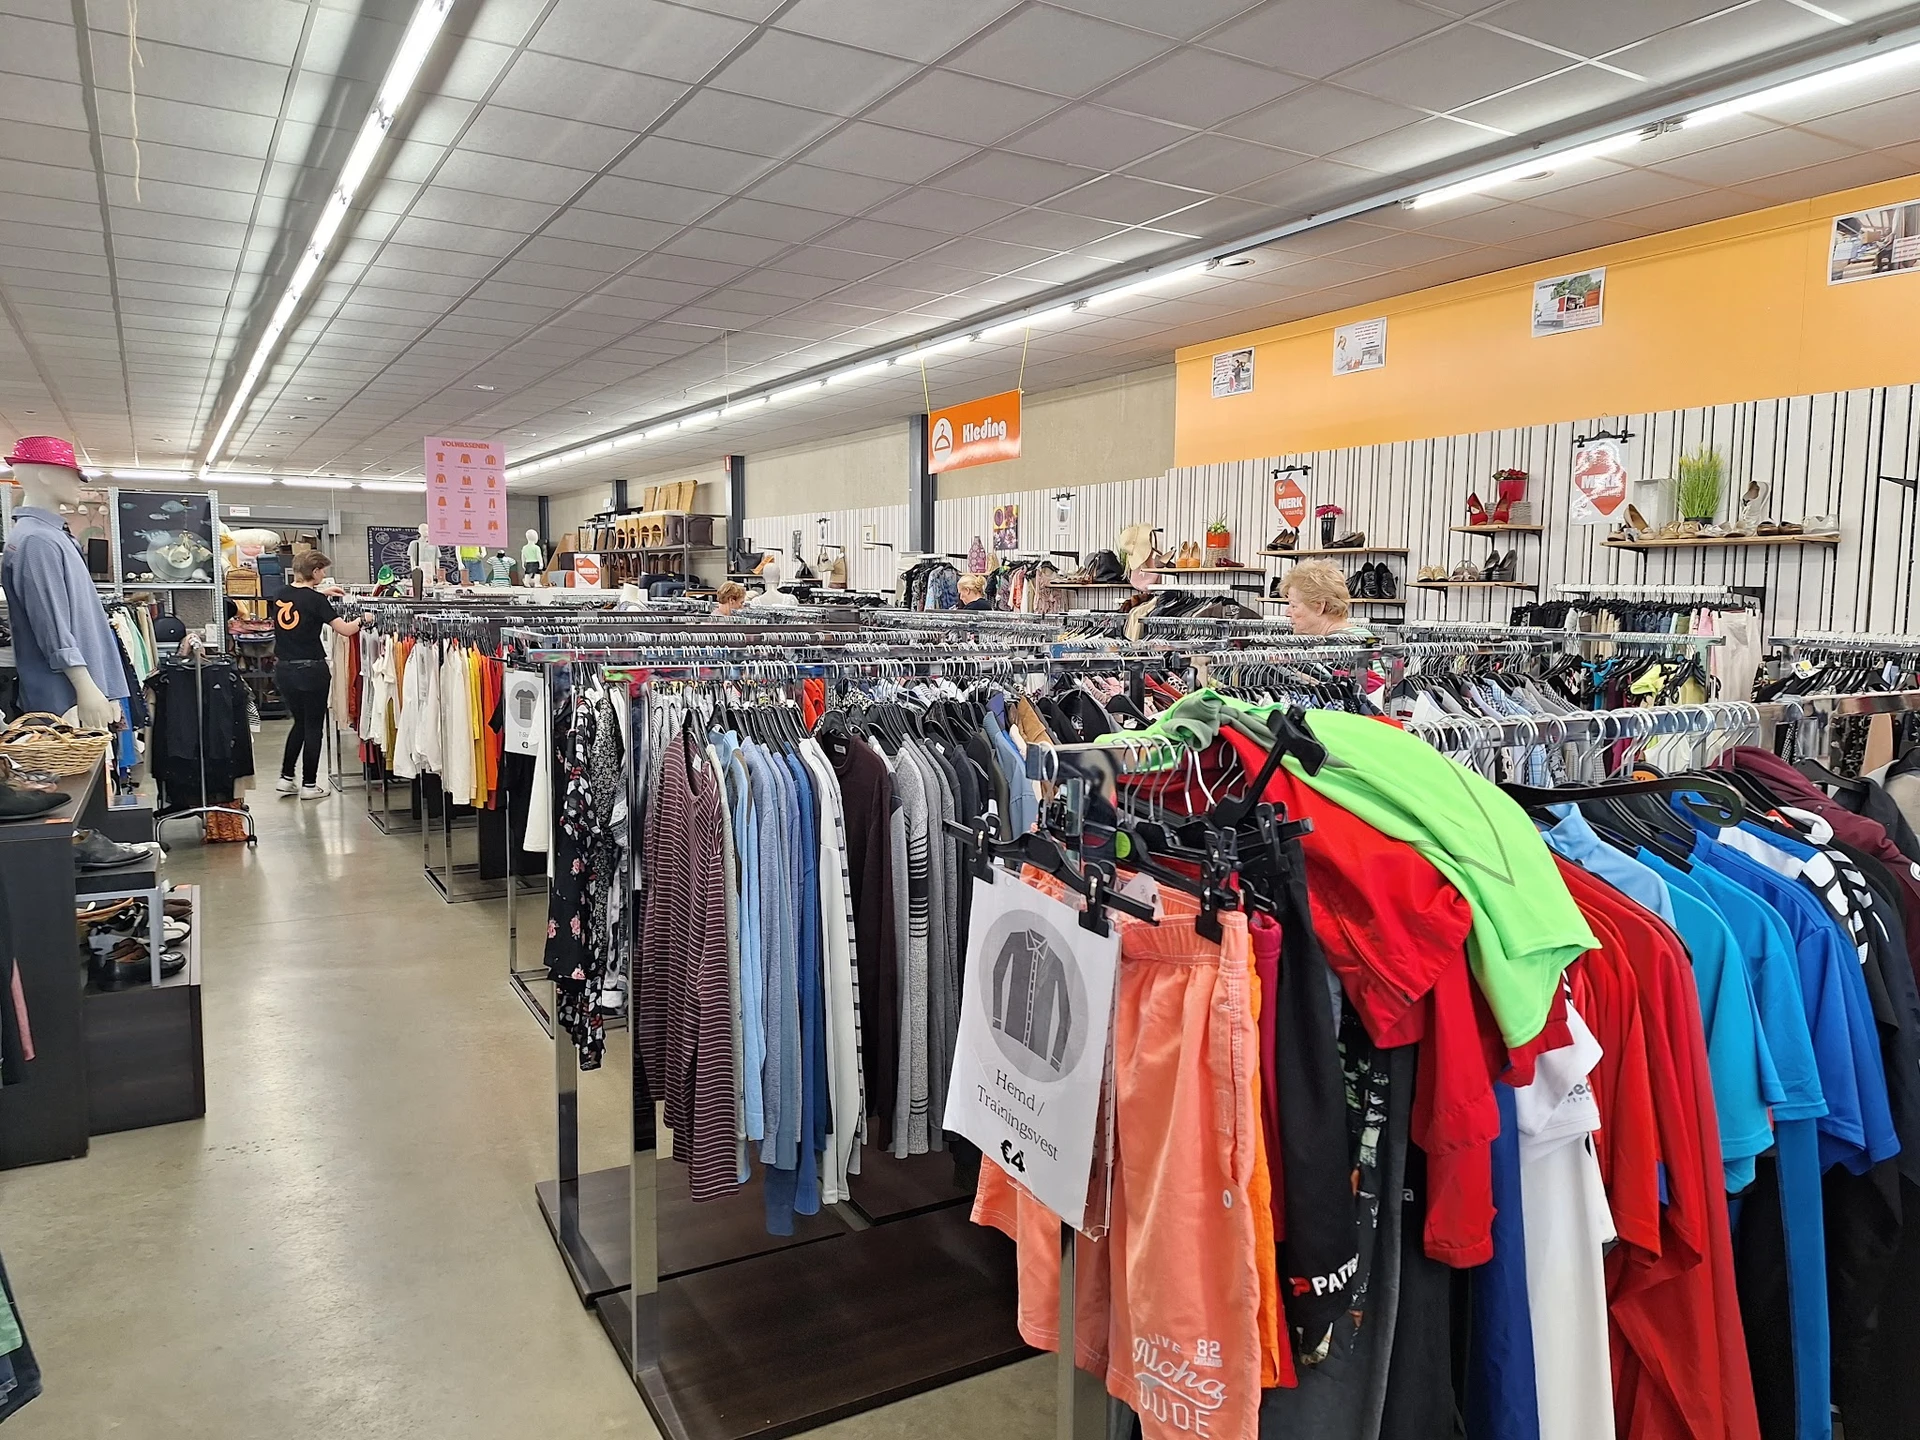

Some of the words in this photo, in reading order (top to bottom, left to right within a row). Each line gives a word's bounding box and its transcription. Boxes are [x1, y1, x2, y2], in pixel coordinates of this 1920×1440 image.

[962, 417, 1007, 444] Kleding
[1278, 496, 1303, 510] MERK
[995, 1069, 1035, 1112] Hemd
[977, 1085, 1059, 1161] Trainingsvest
[1000, 1139, 1026, 1173] €4
[1148, 1333, 1182, 1354] LIVE
[1196, 1338, 1221, 1359] 82
[1132, 1336, 1228, 1400] Aloha
[1140, 1380, 1212, 1439] DUDE
